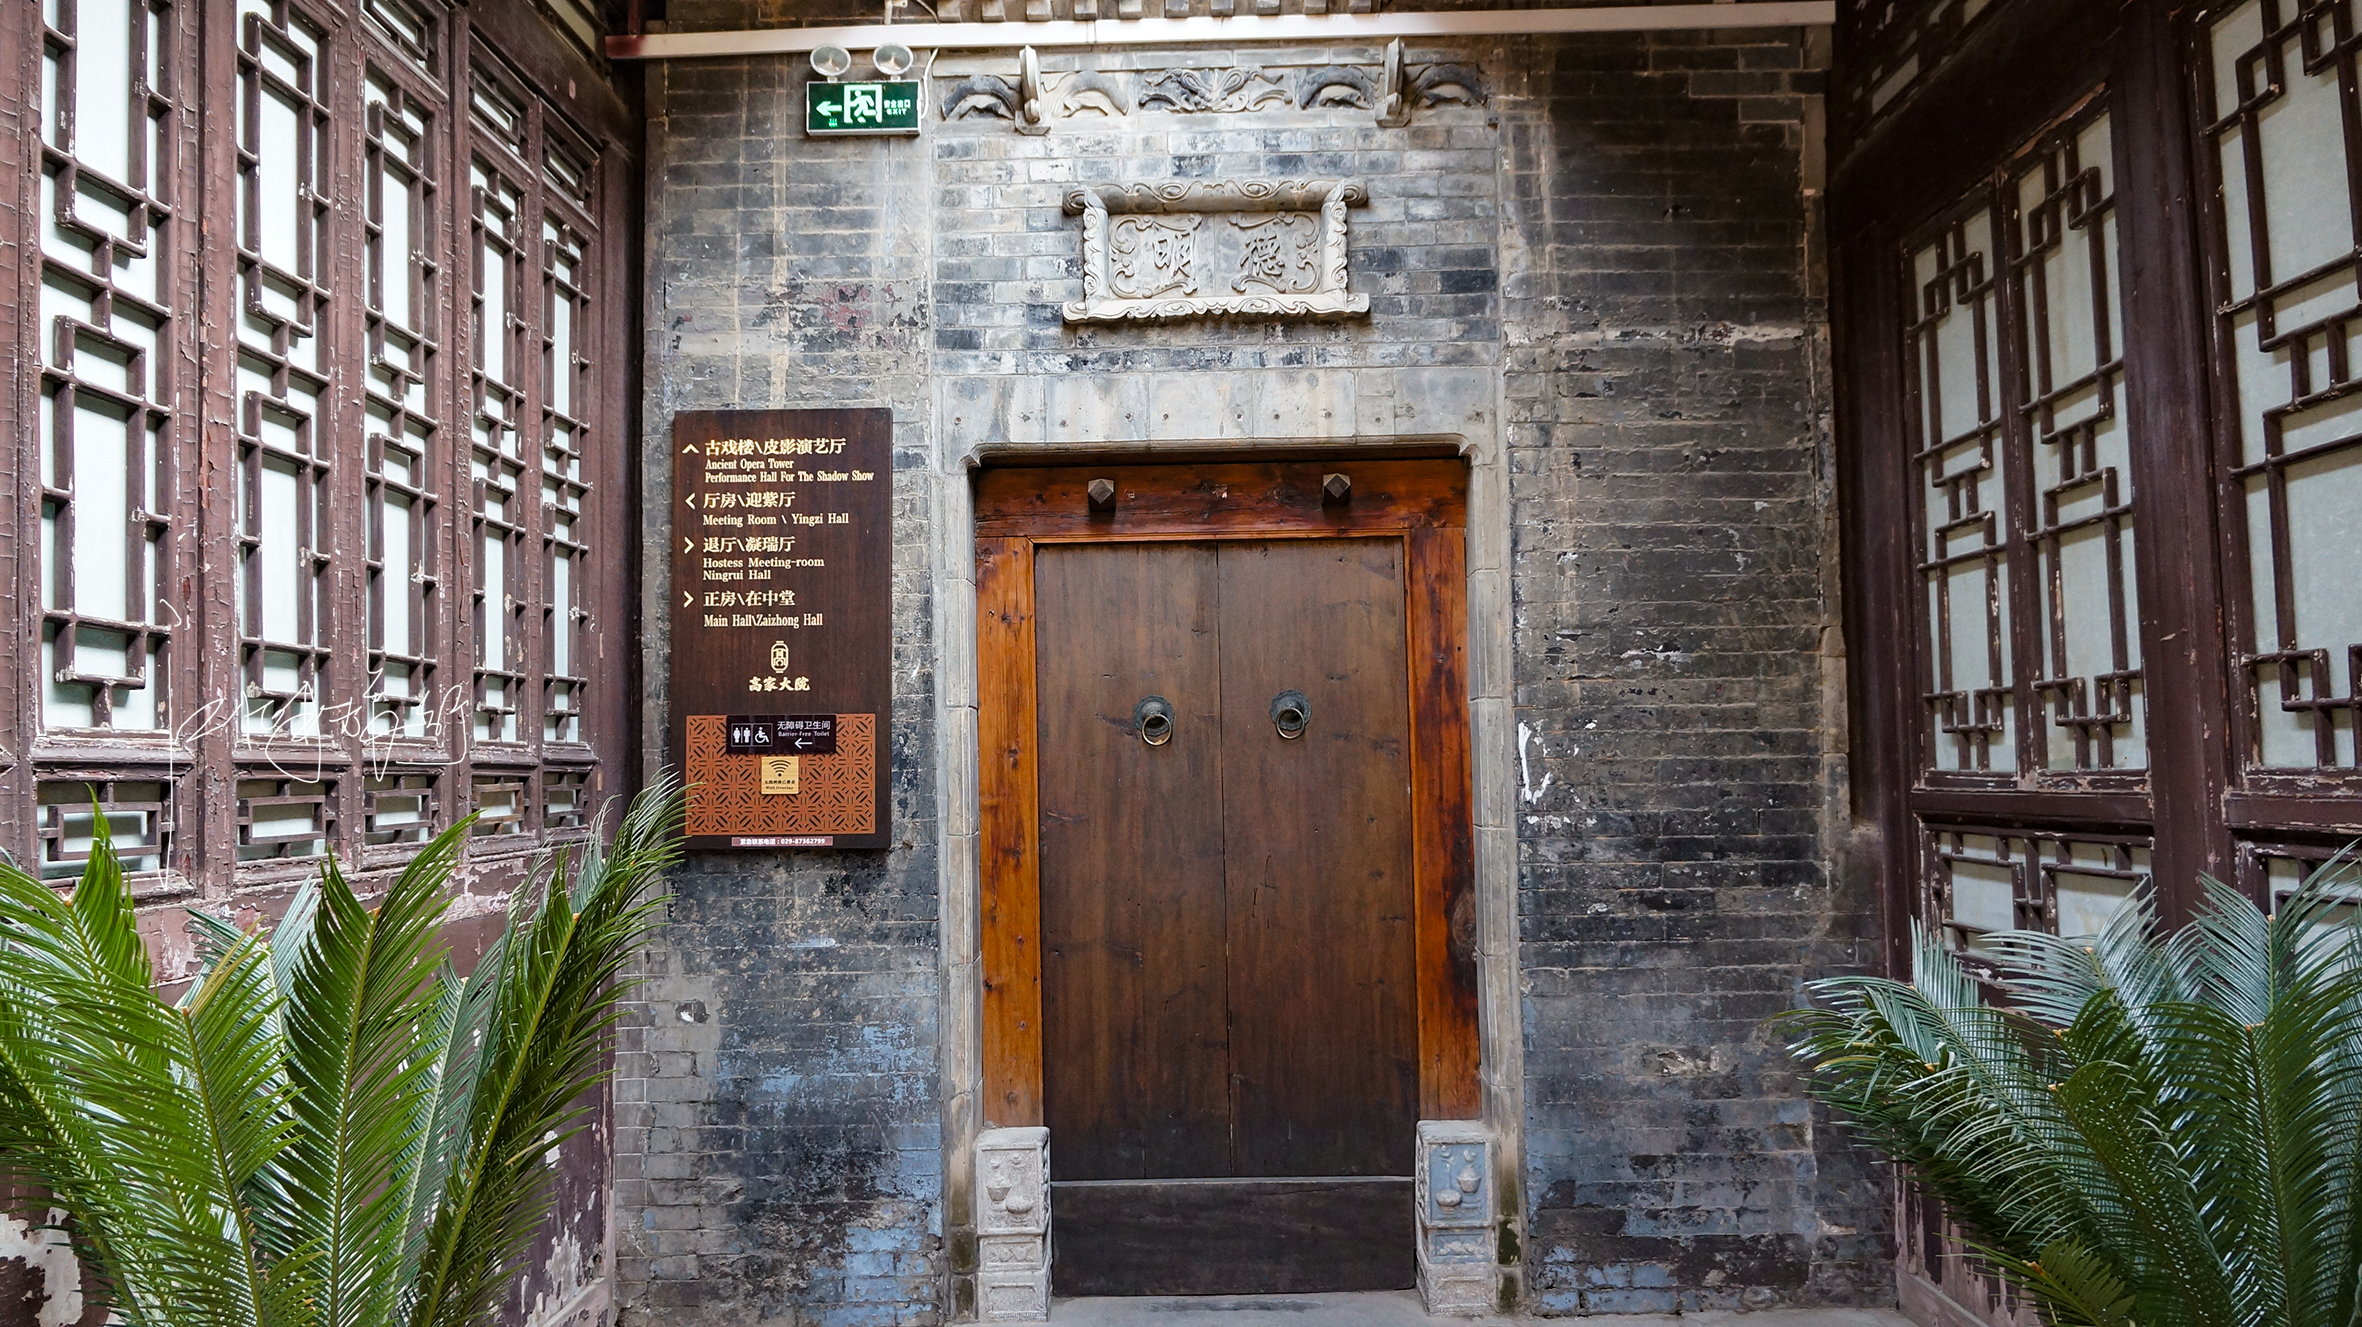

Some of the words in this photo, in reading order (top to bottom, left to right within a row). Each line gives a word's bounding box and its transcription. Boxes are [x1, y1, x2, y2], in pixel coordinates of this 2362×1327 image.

[887, 108, 907, 116] EXIT
[704, 438, 847, 456] 古戏楼\皮影演艺厅
[705, 459, 737, 470] Ancient
[740, 459, 765, 472] Opera
[768, 458, 794, 469] Tower
[705, 471, 757, 483] Performance
[760, 471, 777, 482] Hall
[780, 471, 795, 482] For
[798, 470, 814, 482] The
[817, 470, 849, 481] Shadow
[852, 470, 874, 481] Show
[703, 491, 796, 508] 厅房\迎紫厅
[703, 514, 743, 527] Meeting
[747, 514, 777, 525] Room
[792, 513, 823, 526] Yingzi
[828, 513, 849, 524] Hall
[703, 557, 743, 568] Hostess
[748, 557, 825, 569] Meeting-room
[703, 570, 743, 582] Ningrui
[748, 569, 771, 580] Hall
[703, 590, 796, 607] 正房\在中堂
[704, 614, 728, 627] Main
[732, 613, 799, 629] Hall\Zaizhong
[803, 613, 823, 626] Hall
[748, 676, 811, 693] 高家大院
[777, 720, 831, 730] 无障碍卫生间
